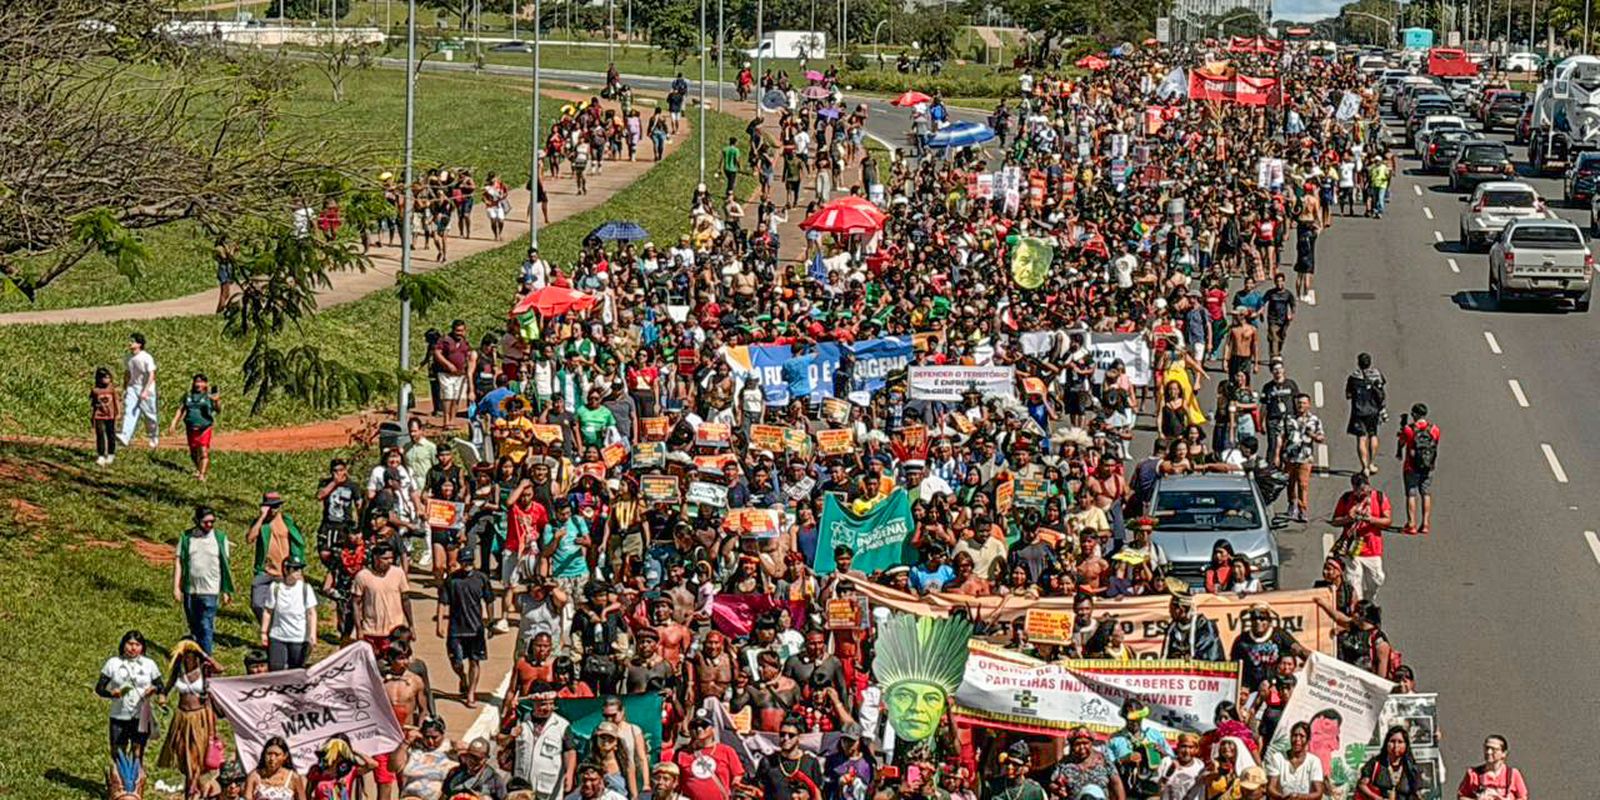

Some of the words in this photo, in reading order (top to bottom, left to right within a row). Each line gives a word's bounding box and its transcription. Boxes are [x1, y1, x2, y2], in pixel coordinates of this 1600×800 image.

[913, 371, 954, 379] DEFENDER
[986, 674, 1055, 690] PARTEIRAS
[1126, 678, 1184, 691] SABERES
[1189, 679, 1219, 692] COM
